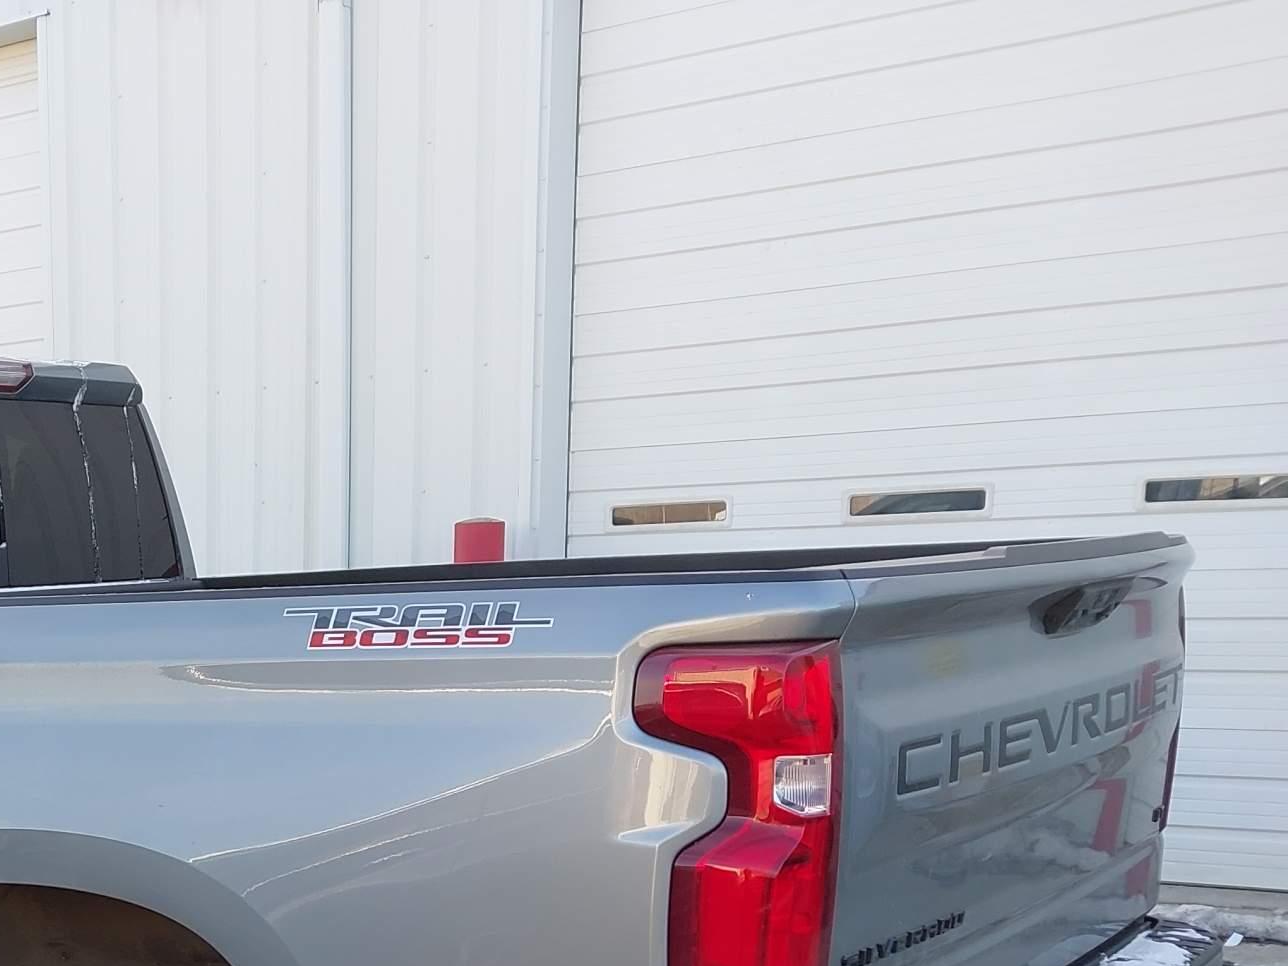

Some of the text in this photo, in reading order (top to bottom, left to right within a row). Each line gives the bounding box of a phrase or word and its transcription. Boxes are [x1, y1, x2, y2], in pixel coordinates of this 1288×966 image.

[283, 601, 553, 630] TRAIL
[307, 626, 515, 650] BOSS
[896, 663, 1183, 796] CHEVROLET
